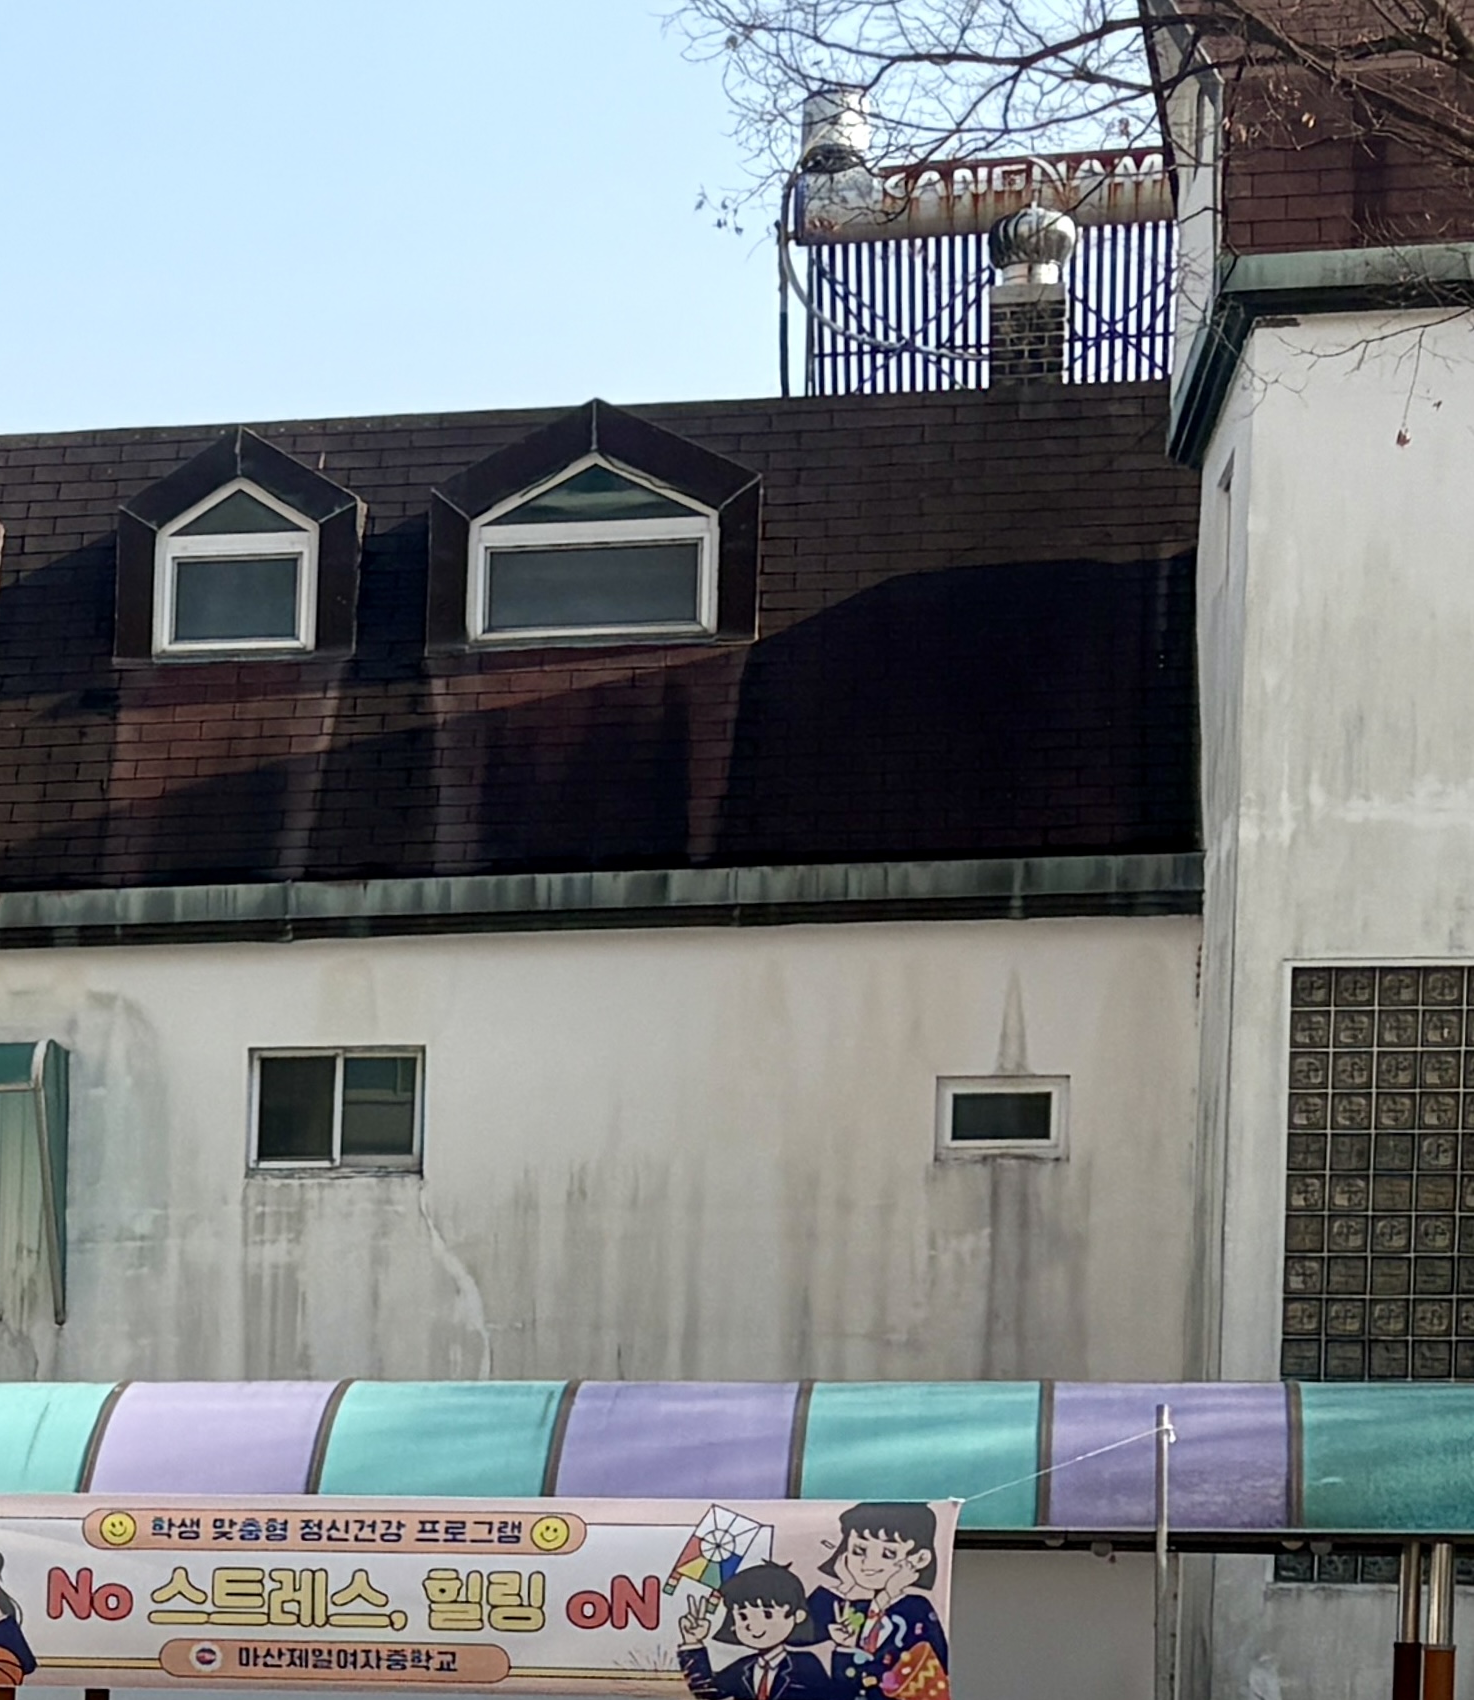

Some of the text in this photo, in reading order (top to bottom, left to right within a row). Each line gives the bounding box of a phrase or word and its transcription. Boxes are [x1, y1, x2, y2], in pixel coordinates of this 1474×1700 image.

[151, 1516, 523, 1545] 학생 맞춤형 정신건강 프로그램
[46, 1565, 661, 1632] No 스트레스, 힐링 oN
[237, 1646, 458, 1674] 마산제일여자중학교
